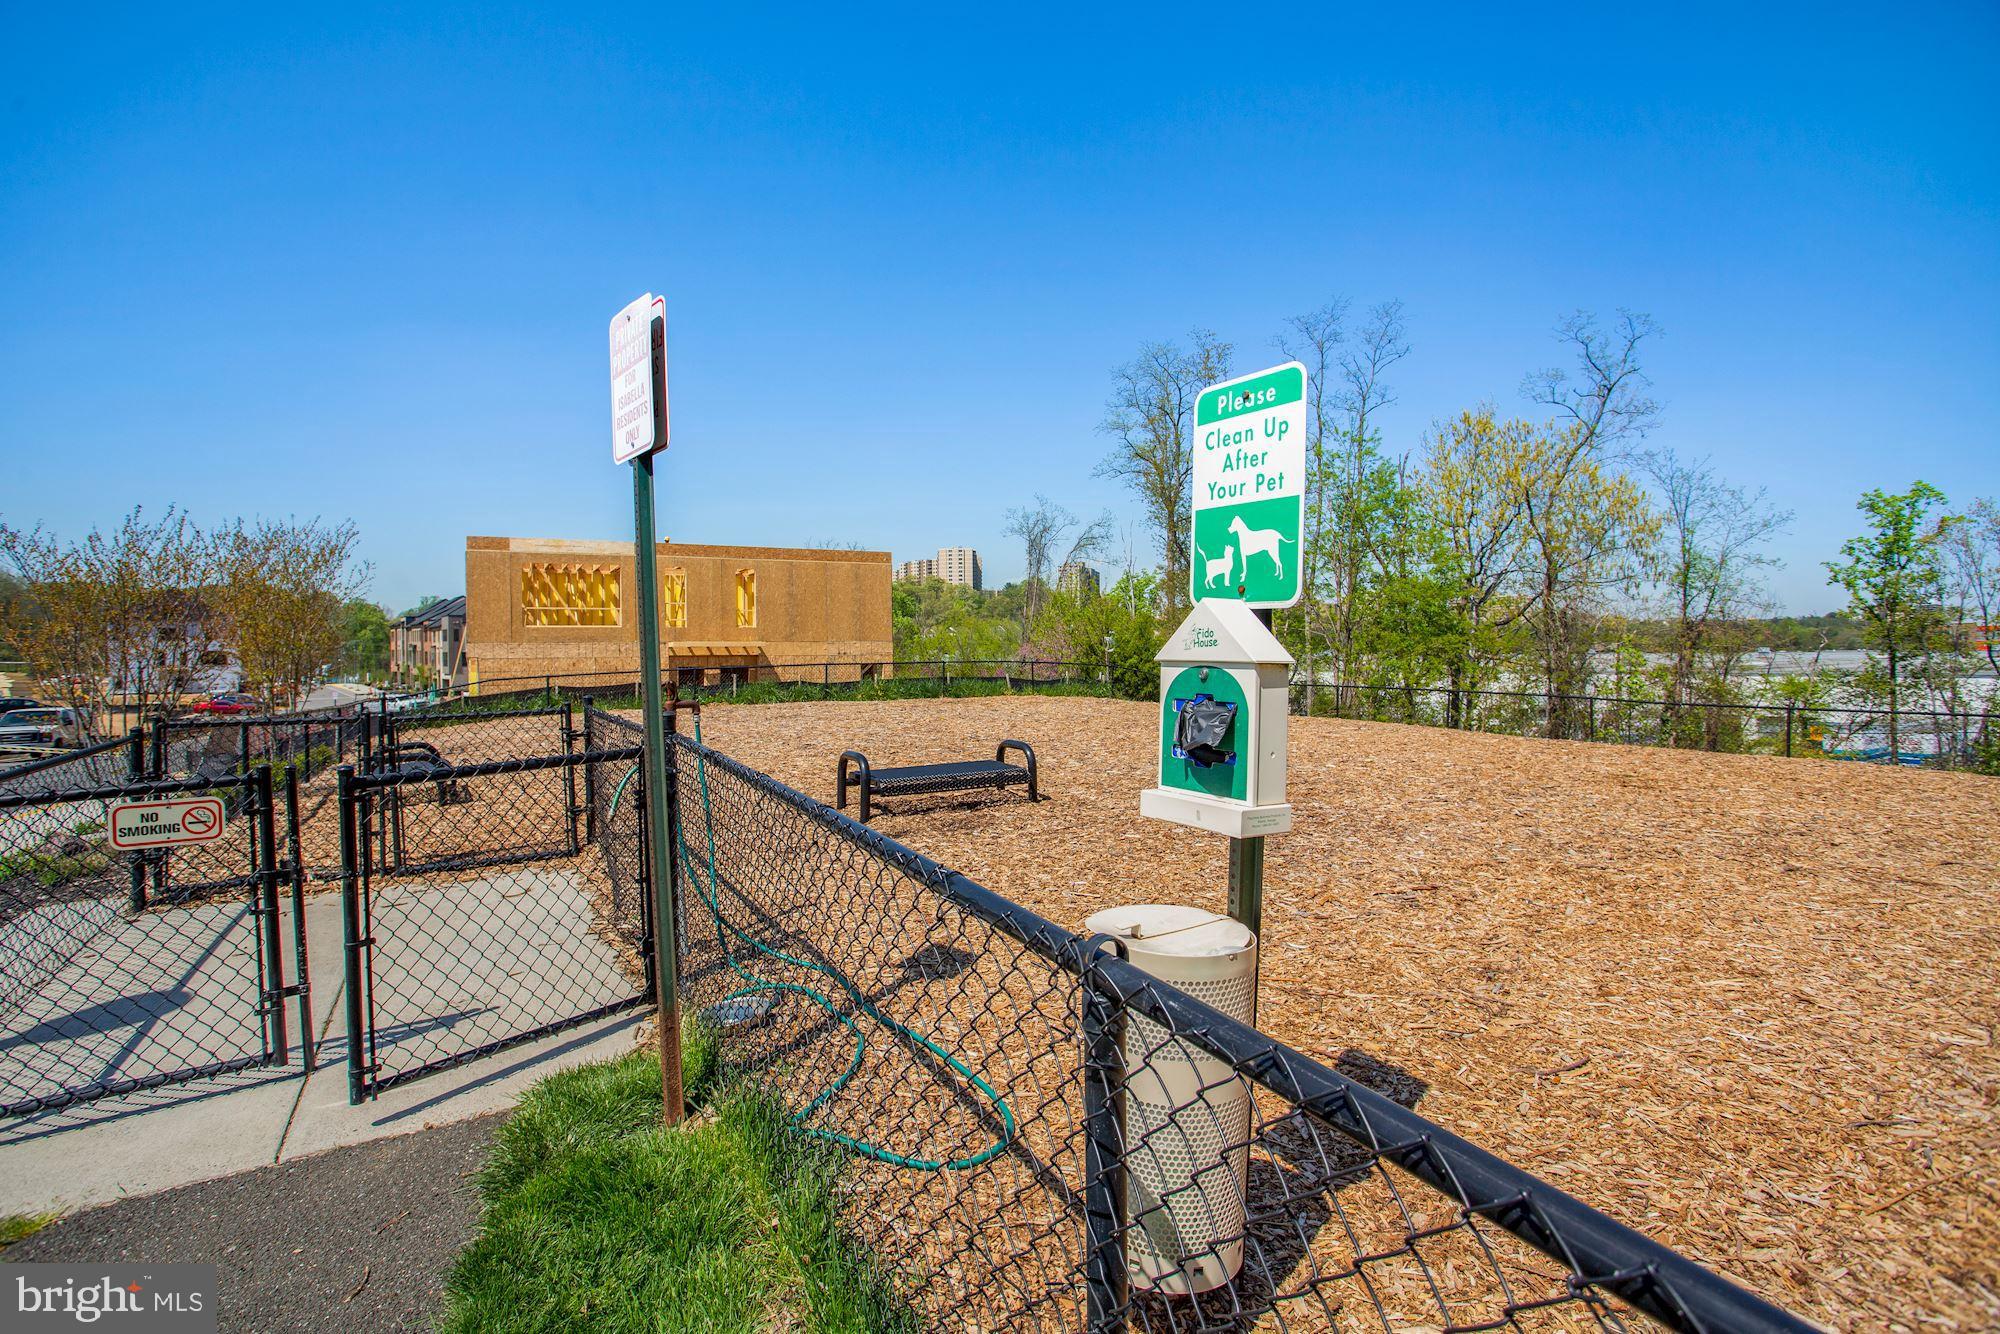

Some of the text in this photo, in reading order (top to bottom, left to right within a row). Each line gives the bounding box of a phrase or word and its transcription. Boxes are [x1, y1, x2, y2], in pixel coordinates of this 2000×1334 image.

[624, 369, 637, 389] FOR
[618, 382, 646, 412] ISABELLA
[1217, 387, 1276, 415] Please
[616, 400, 648, 431] RESIDENTS
[625, 424, 640, 445] ONLY
[1205, 416, 1289, 451] Clean Up
[1222, 448, 1268, 473] After
[1207, 472, 1284, 501] Your Pet
[1193, 638, 1218, 648] House
[1196, 627, 1214, 639] Fido
[140, 812, 159, 823] NO
[118, 823, 181, 838] SMOKING
